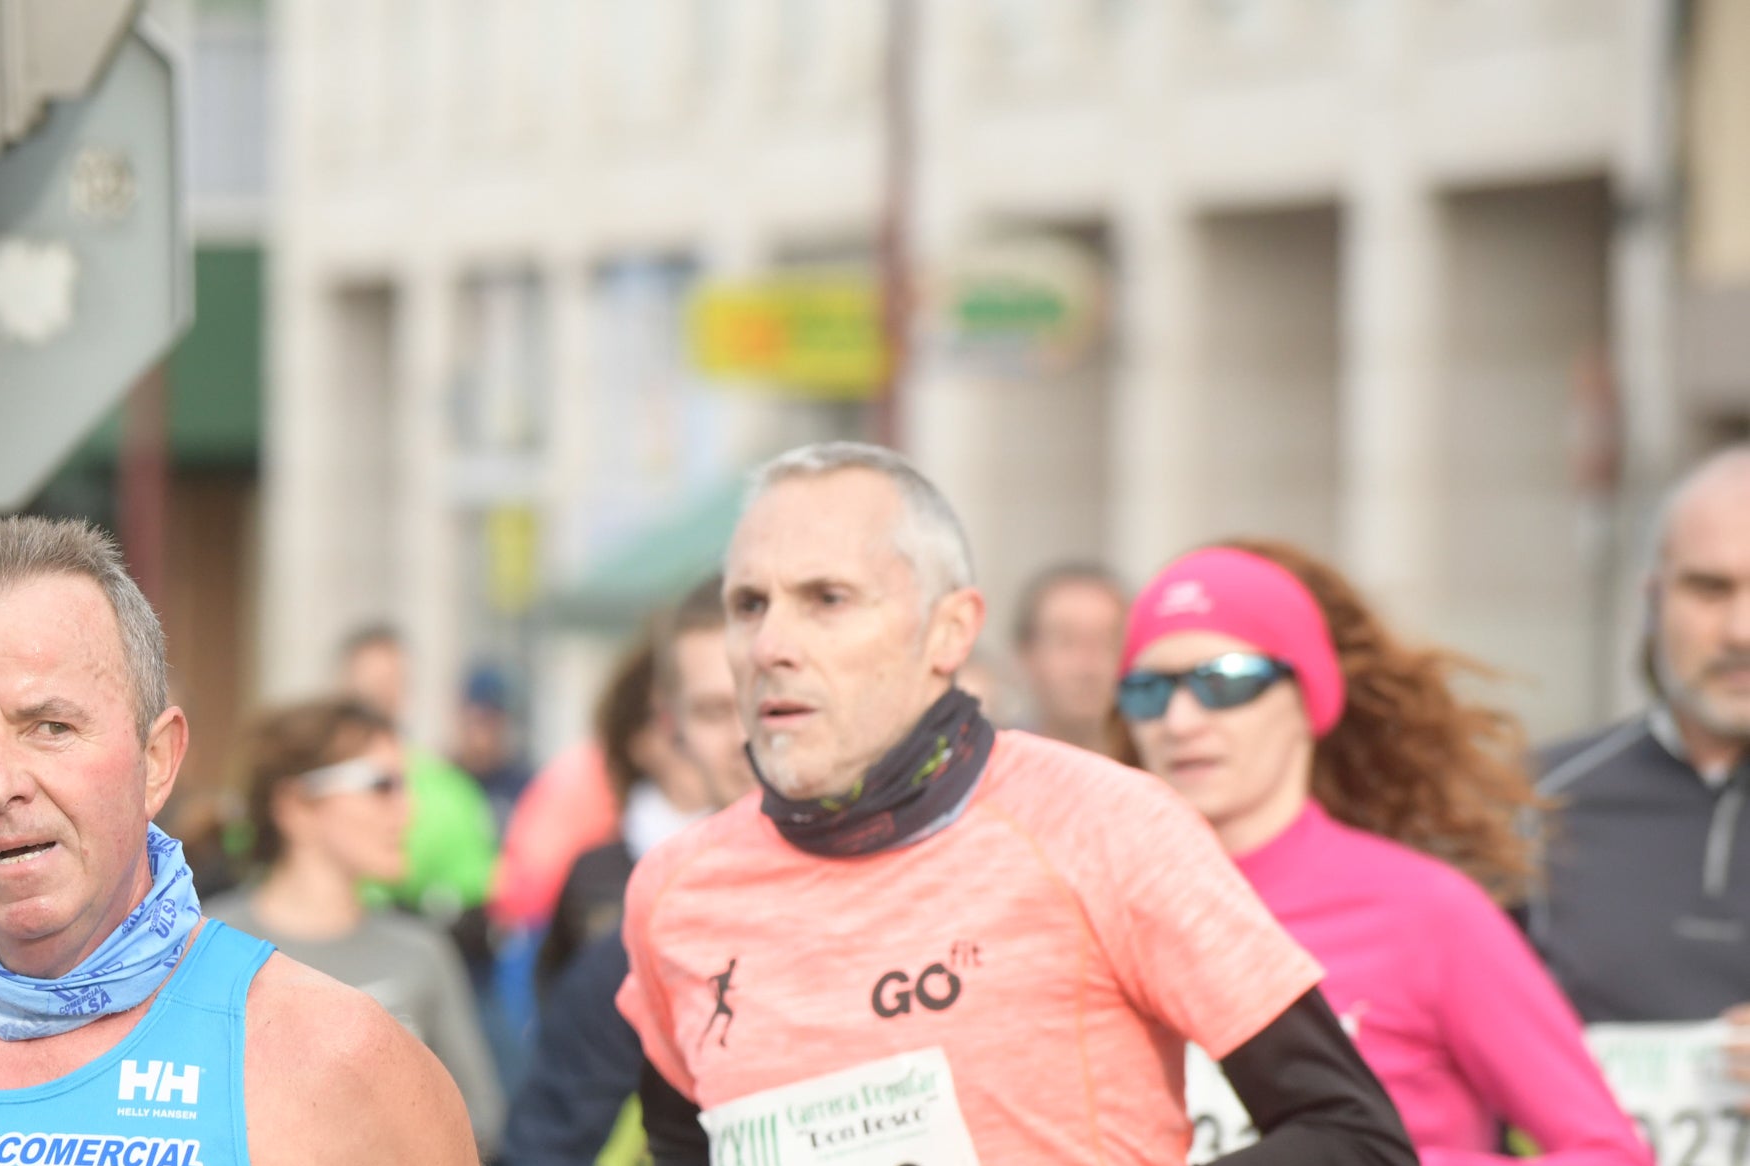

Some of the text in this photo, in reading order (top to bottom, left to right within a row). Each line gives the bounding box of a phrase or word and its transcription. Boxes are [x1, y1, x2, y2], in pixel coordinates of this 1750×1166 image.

[117, 1059, 200, 1104] HH
[117, 1108, 197, 1120] HELLY HANSEN
